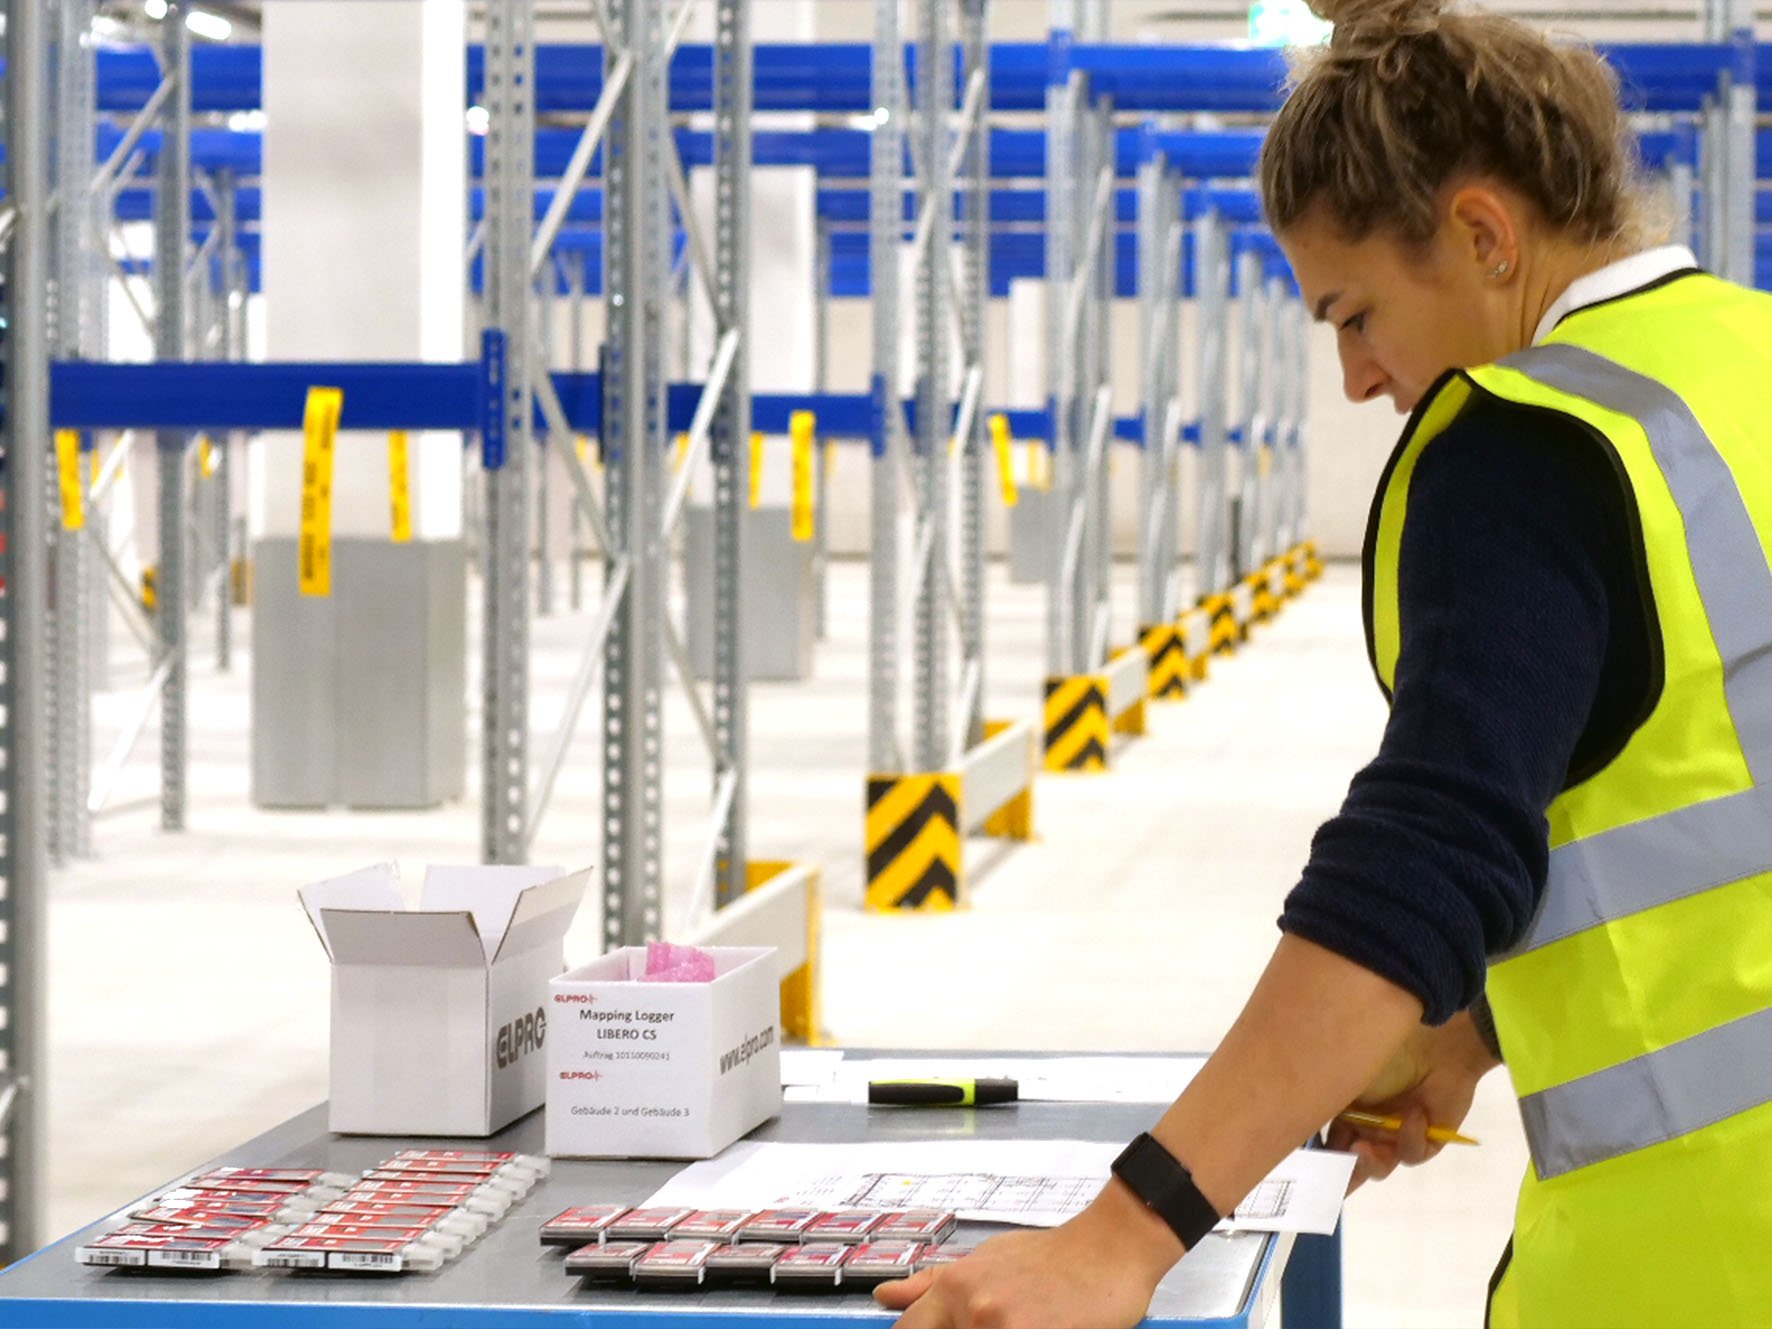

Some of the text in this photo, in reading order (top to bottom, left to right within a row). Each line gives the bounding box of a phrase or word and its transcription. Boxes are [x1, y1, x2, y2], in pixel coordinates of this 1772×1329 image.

[554, 994, 590, 1004] ELPRO
[579, 1009, 674, 1024] Mapping Logger
[596, 1028, 657, 1041] LIBERO CS
[720, 1025, 774, 1075] www.elpro.com
[560, 1071, 597, 1081] ELPRO
[570, 1105, 690, 1118] Gebäude 2 und Gebäude 3
